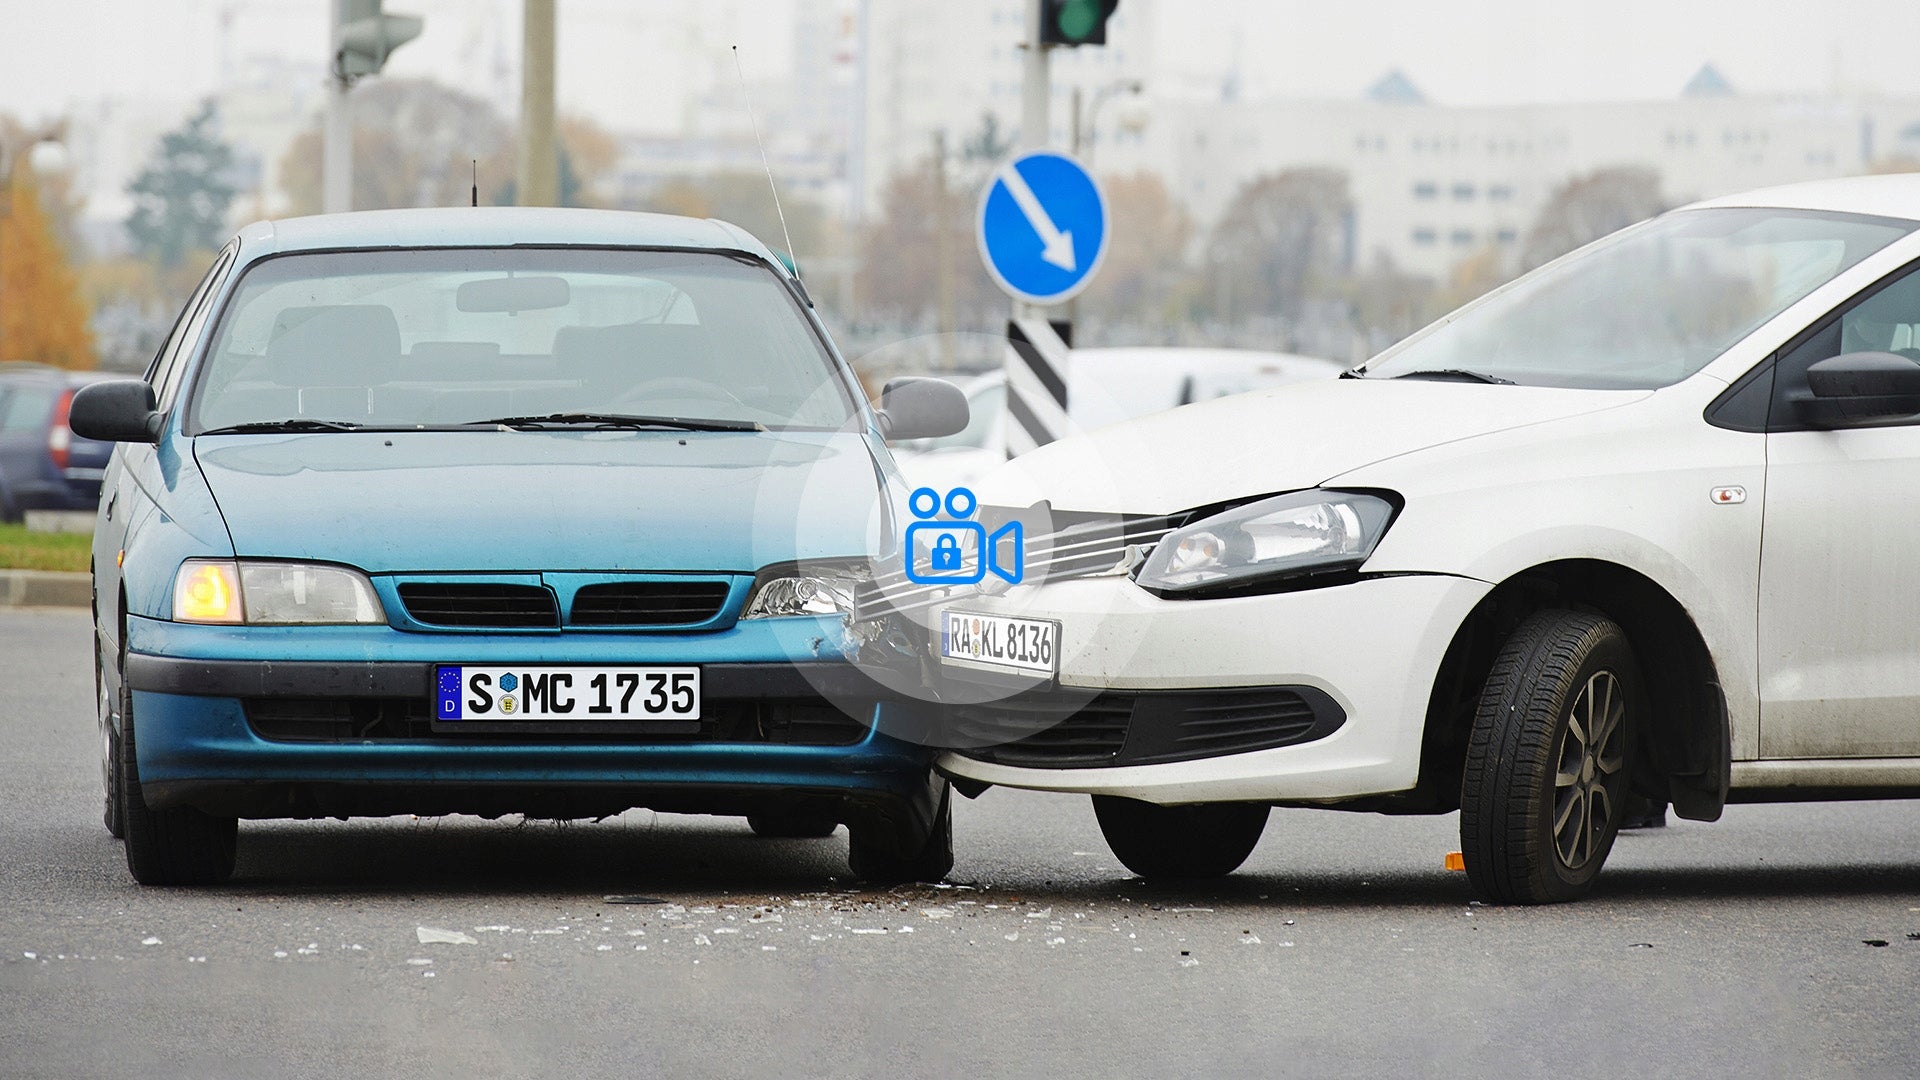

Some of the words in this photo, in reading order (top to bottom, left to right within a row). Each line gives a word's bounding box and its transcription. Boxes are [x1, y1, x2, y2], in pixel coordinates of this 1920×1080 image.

[951, 617, 971, 653] RA
[982, 620, 1003, 658] KL
[1007, 623, 1051, 664] 8136
[445, 701, 455, 713] D
[468, 673, 493, 714] S
[522, 673, 575, 714] MC
[588, 673, 695, 714] 1735
